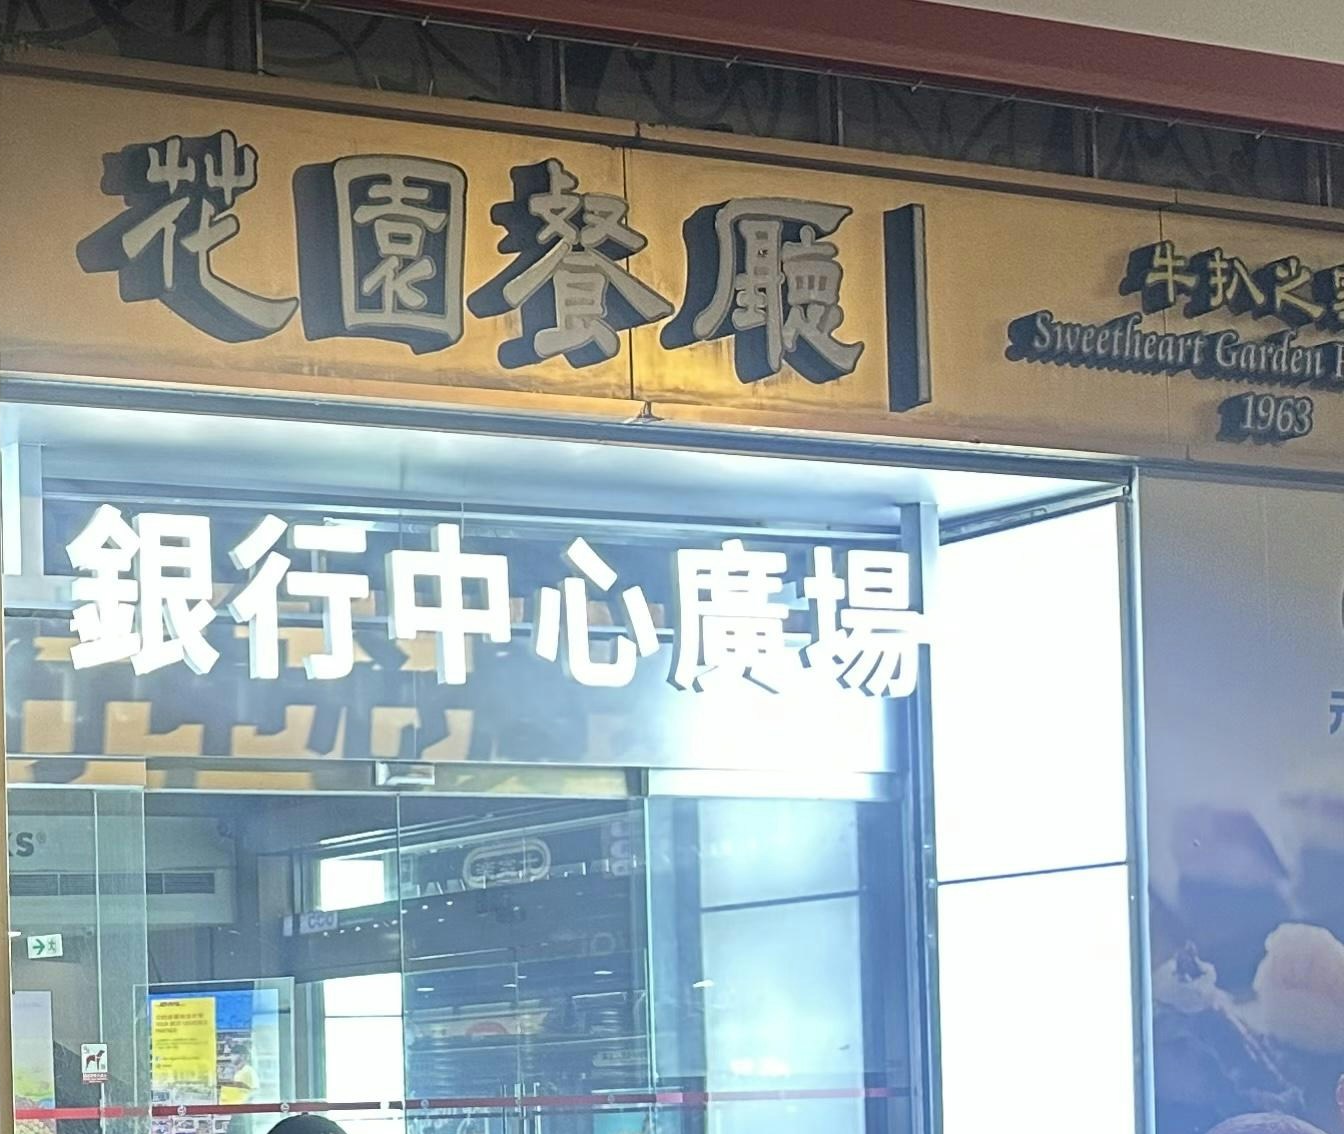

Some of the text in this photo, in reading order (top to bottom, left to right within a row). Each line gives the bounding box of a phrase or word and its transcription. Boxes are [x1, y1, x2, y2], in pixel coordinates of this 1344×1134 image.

[76, 129, 865, 384] 花園餐廳
[1014, 309, 1206, 373] Sweetheart
[1208, 327, 1325, 384] Garden
[1224, 392, 1314, 440] 1963
[66, 503, 926, 697] 銀行中心廣場
